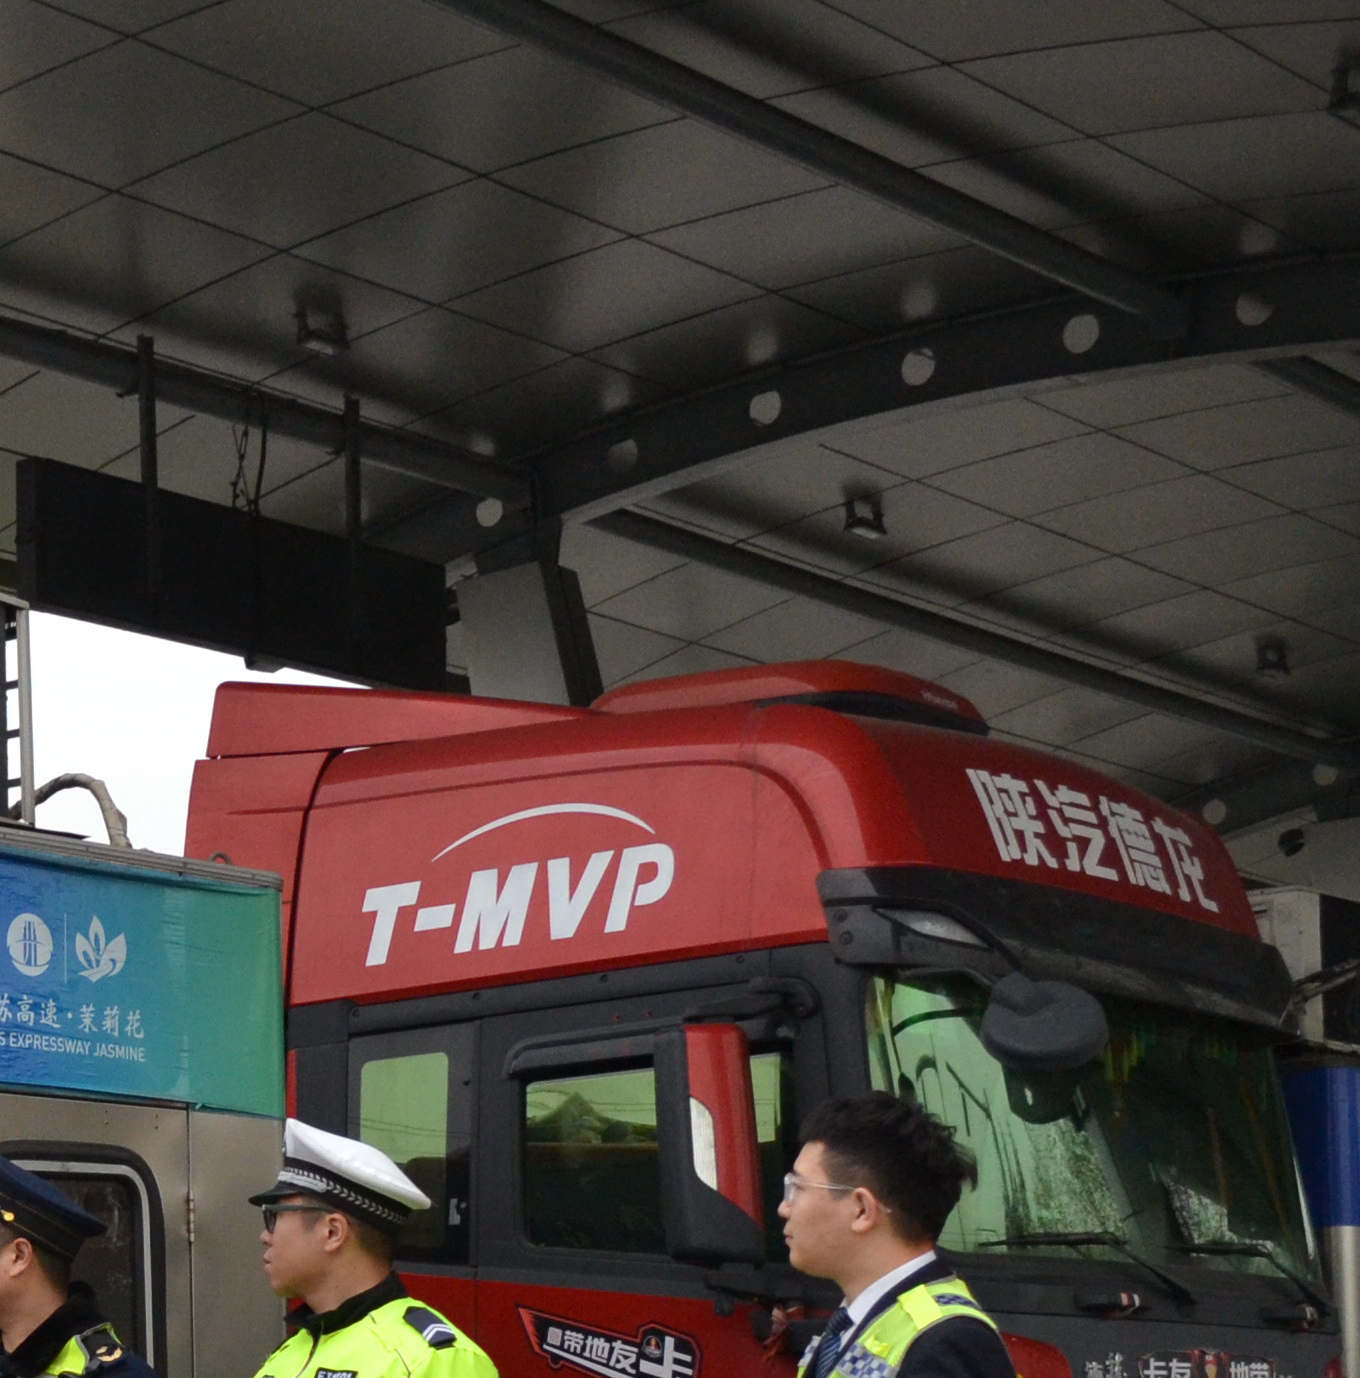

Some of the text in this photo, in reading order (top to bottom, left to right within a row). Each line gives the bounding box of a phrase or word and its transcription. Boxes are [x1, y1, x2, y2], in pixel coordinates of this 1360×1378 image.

[965, 768, 1219, 913] 陕汽德龙
[362, 843, 675, 967] T-MVP
[10, 1033, 91, 1055] EXPRESSWAY
[93, 1042, 146, 1062] JASMINE
